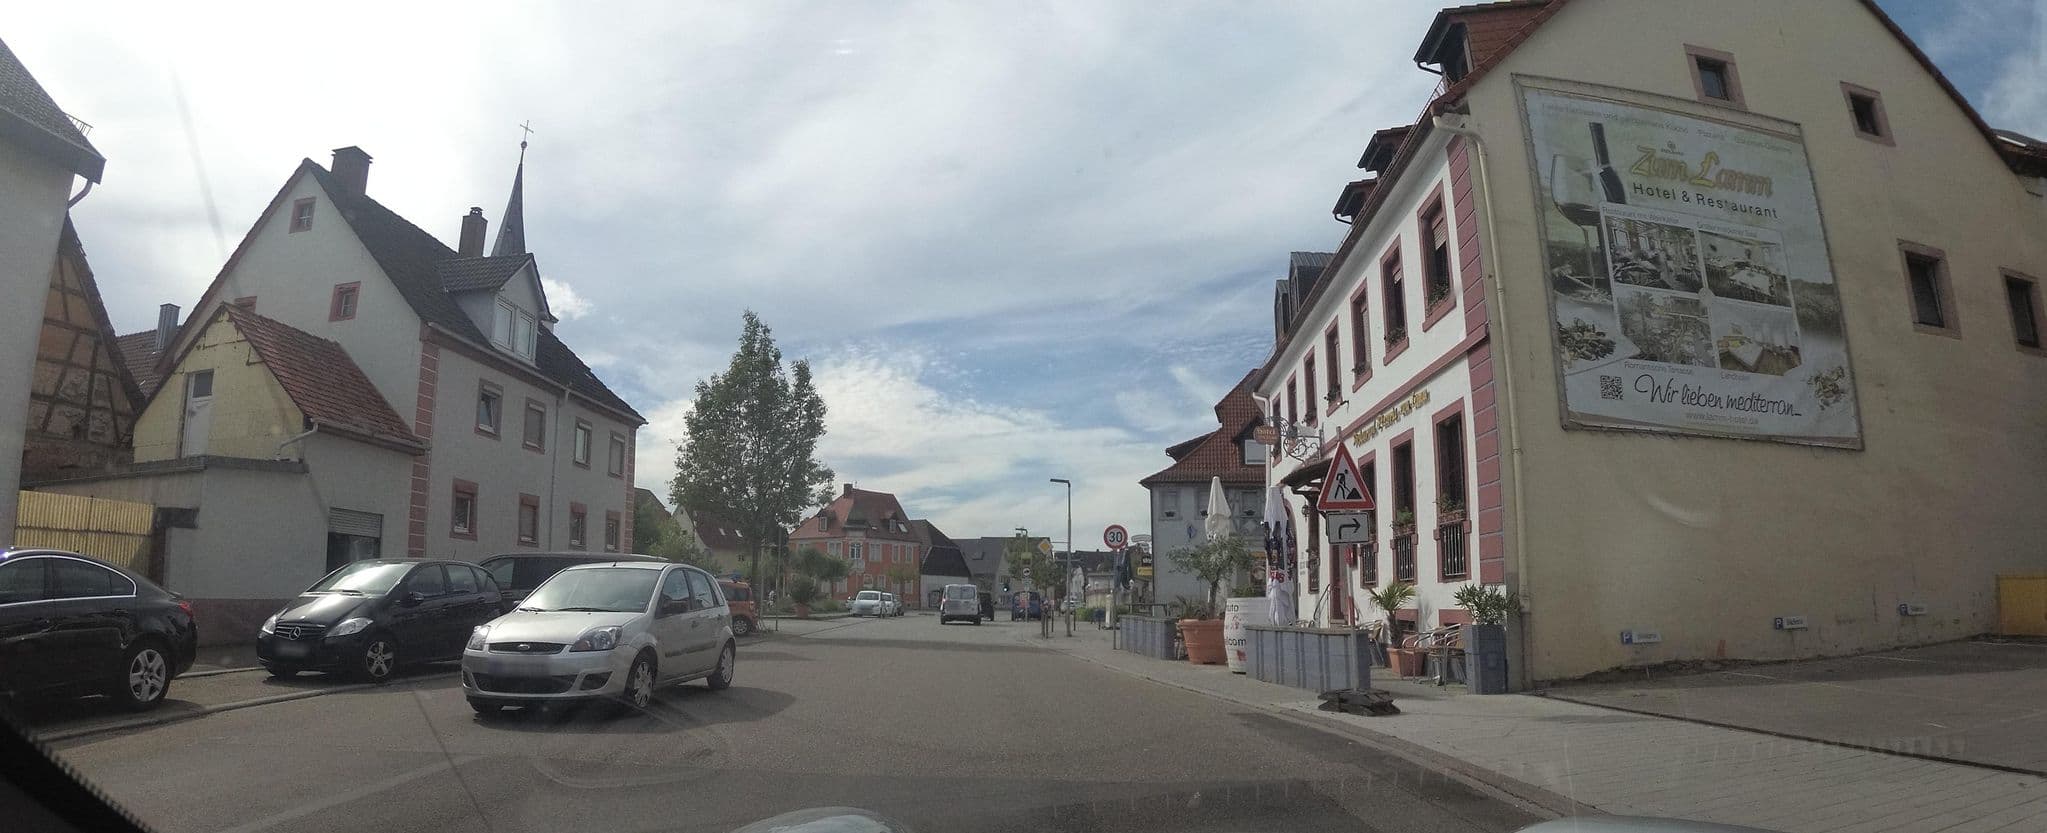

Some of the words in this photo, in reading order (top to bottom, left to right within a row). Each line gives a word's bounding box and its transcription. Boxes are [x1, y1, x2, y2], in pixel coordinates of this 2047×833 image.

[1631, 145, 1688, 182] Zum
[1689, 151, 1775, 199] Lamm
[1633, 182, 1676, 200] Hotel
[1681, 190, 1690, 202] &
[1694, 193, 1779, 219] Restaurant
[1635, 374, 1679, 403] Wir
[1682, 384, 1723, 409] lieben
[1109, 532, 1122, 542] 30
